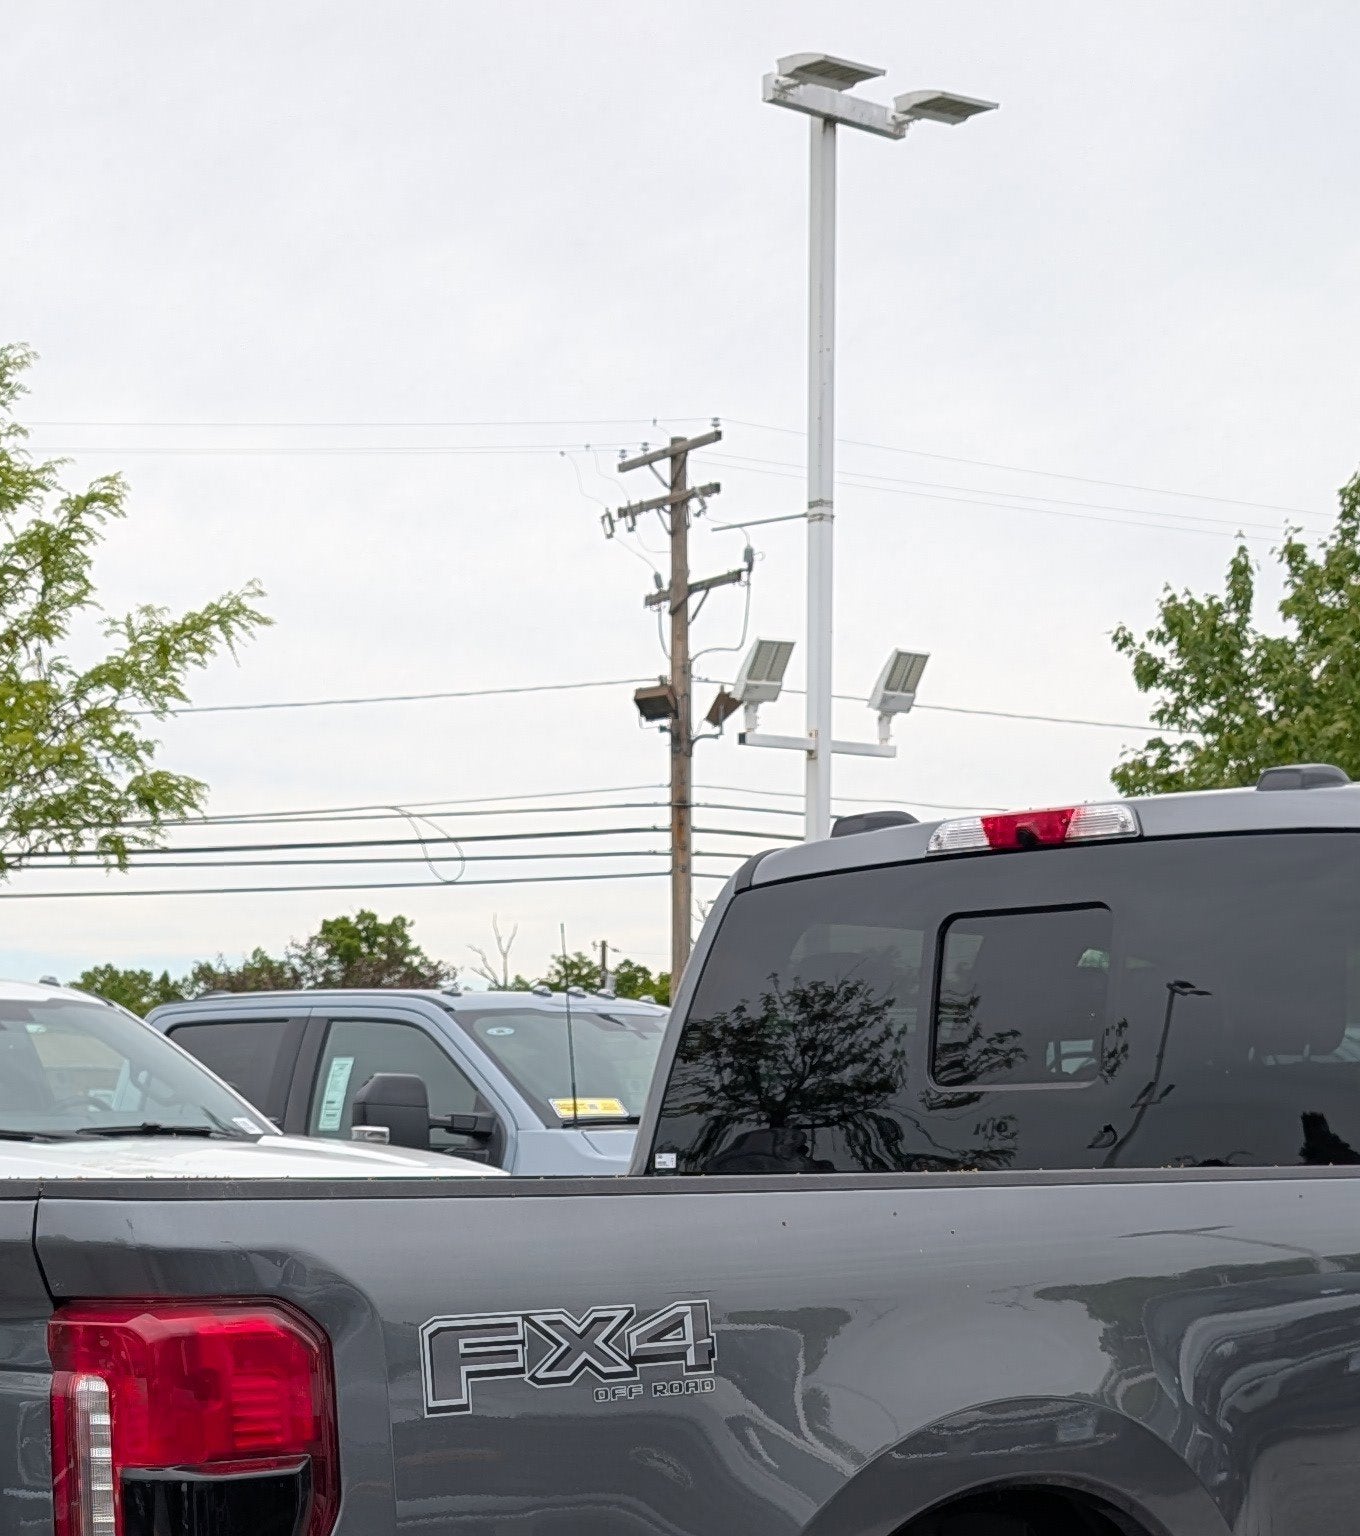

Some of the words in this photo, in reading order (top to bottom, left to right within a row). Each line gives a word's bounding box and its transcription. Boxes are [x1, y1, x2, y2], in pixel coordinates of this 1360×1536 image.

[419, 1299, 717, 1418] FX4
[594, 1384, 644, 1403] OFF
[651, 1377, 716, 1398] ROAD
